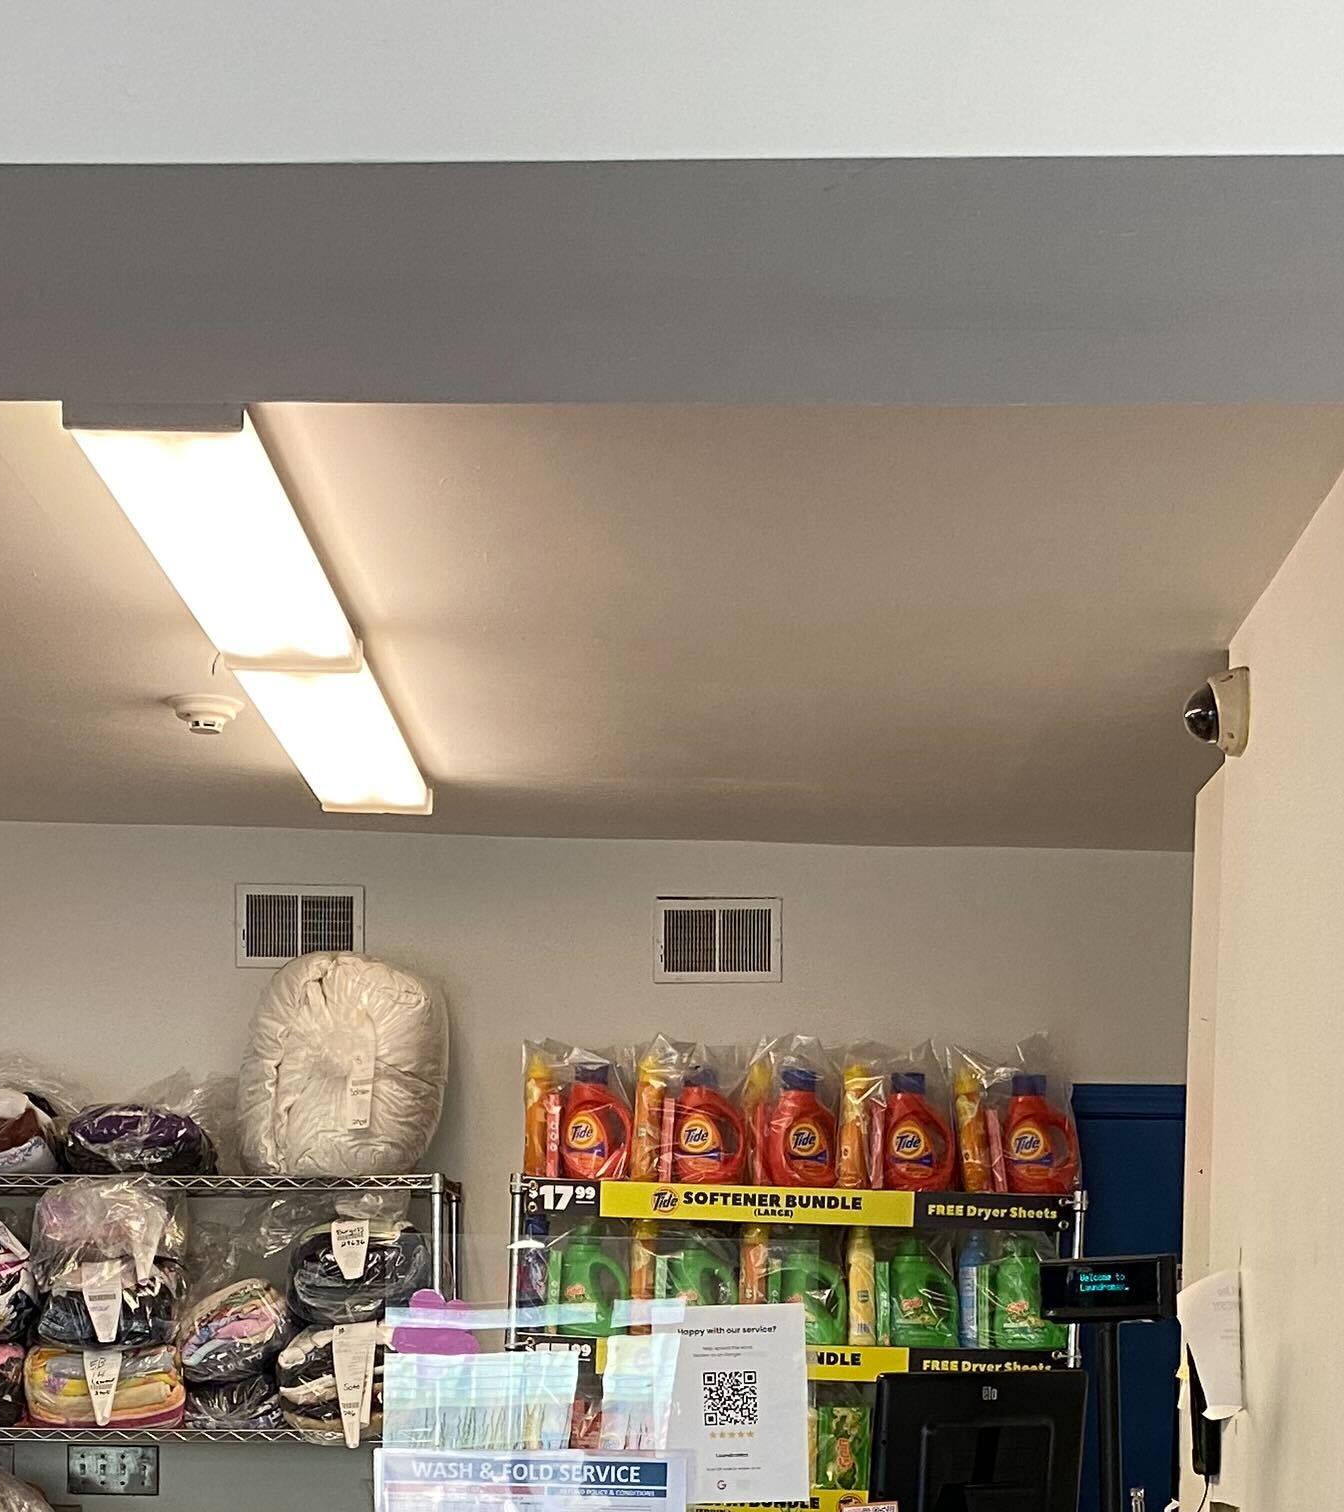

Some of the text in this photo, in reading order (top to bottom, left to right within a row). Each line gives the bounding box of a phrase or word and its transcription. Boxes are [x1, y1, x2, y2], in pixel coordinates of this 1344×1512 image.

[570, 1124, 593, 1142] Tide
[684, 1128, 708, 1145] Tide
[793, 1130, 816, 1148] Tide
[896, 1134, 921, 1152] Tide
[1014, 1134, 1040, 1152] Tide
[653, 1191, 862, 1211] Tide SOFTENER BUNDLE
[754, 1208, 794, 1218] (LARGE)
[928, 1204, 1057, 1220] FREE Dryer Sheets
[678, 1327, 705, 1336] Happy
[742, 1326, 777, 1334] service?
[816, 1352, 862, 1366] NDLE
[923, 1360, 958, 1371] FREE
[412, 1462, 641, 1483] WASH & FOLD SERVICE
